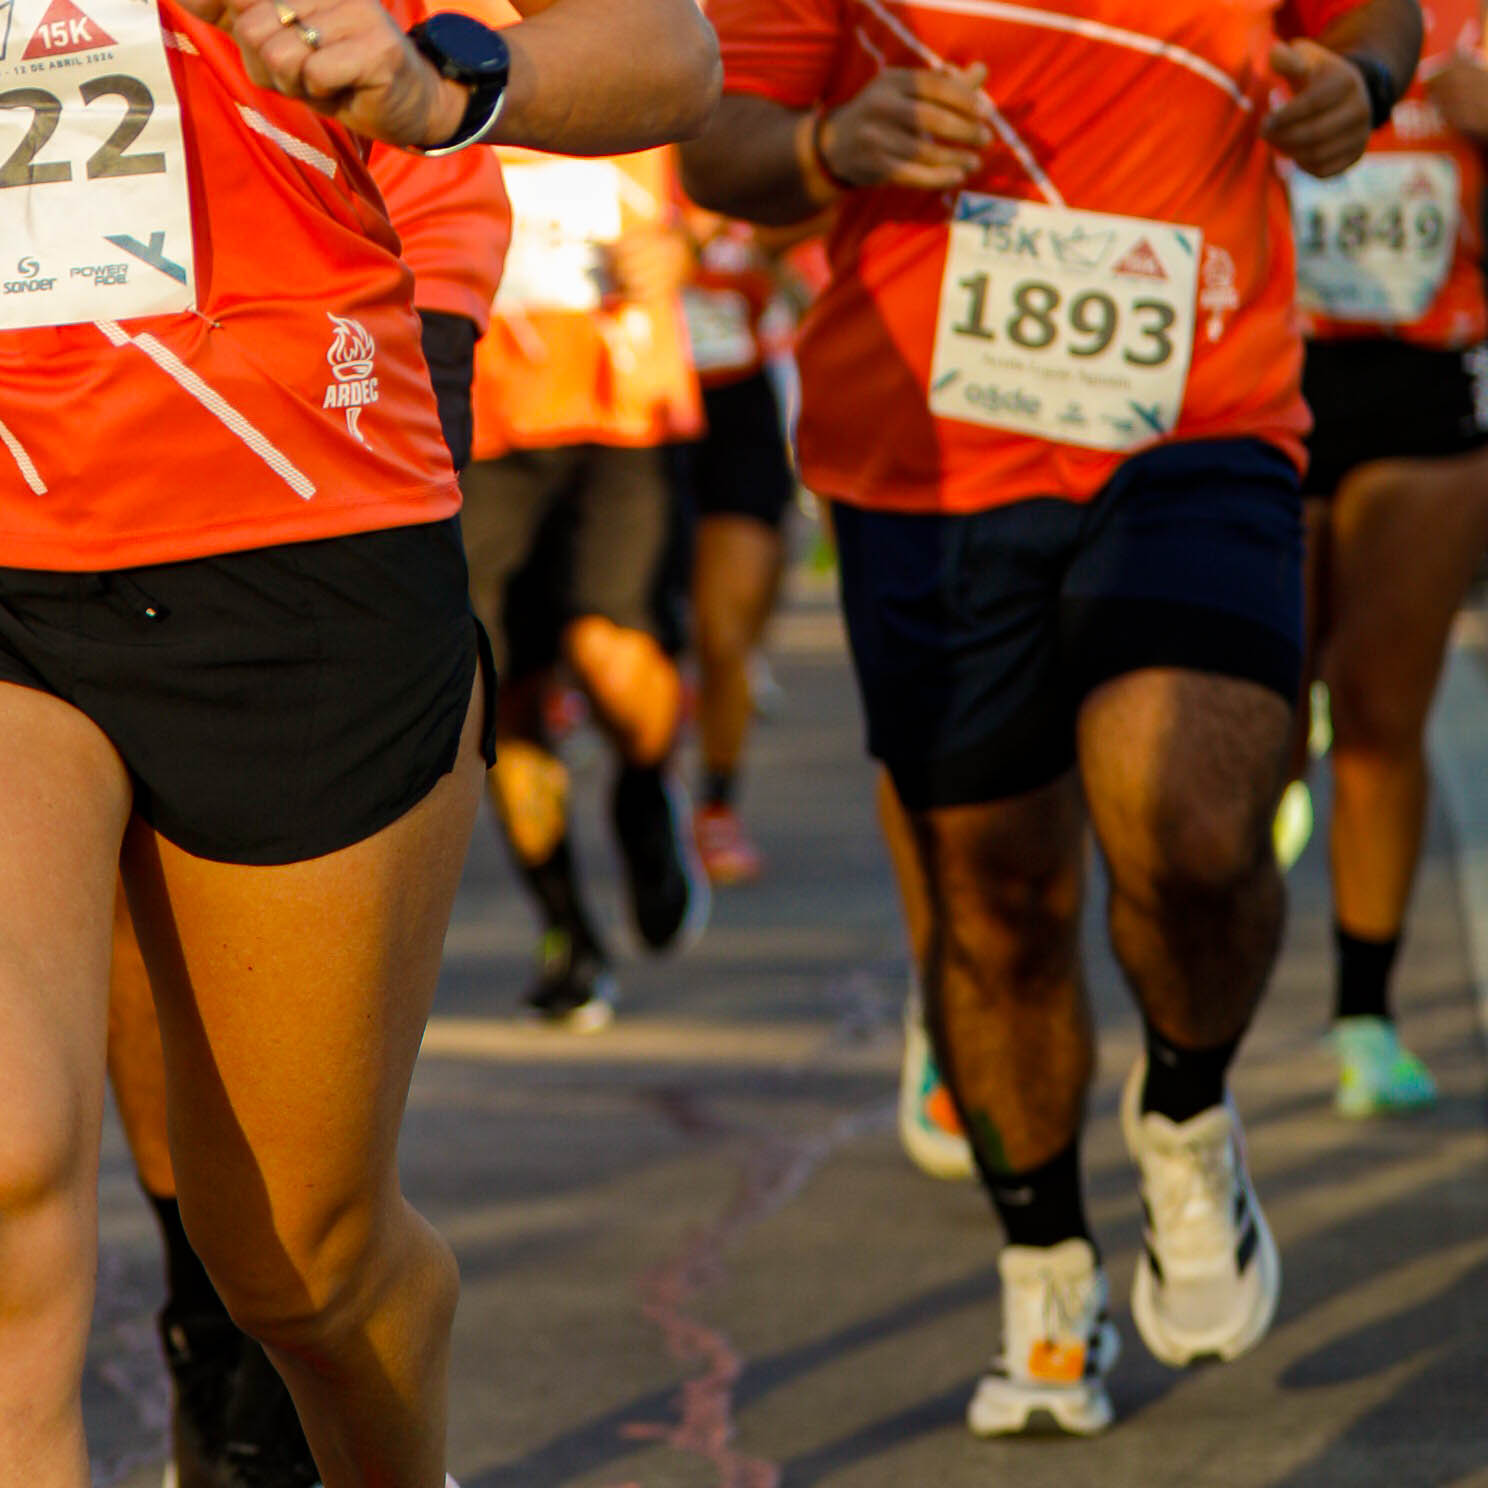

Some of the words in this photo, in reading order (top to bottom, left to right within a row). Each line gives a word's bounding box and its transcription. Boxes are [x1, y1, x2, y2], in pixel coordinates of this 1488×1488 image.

[38, 16, 93, 49] 15K
[14, 65, 27, 75] 12
[30, 62, 45, 73] DE
[49, 57, 83, 70] ABRIL
[951, 270, 1178, 368] 1893
[323, 377, 380, 409] ARDEC
